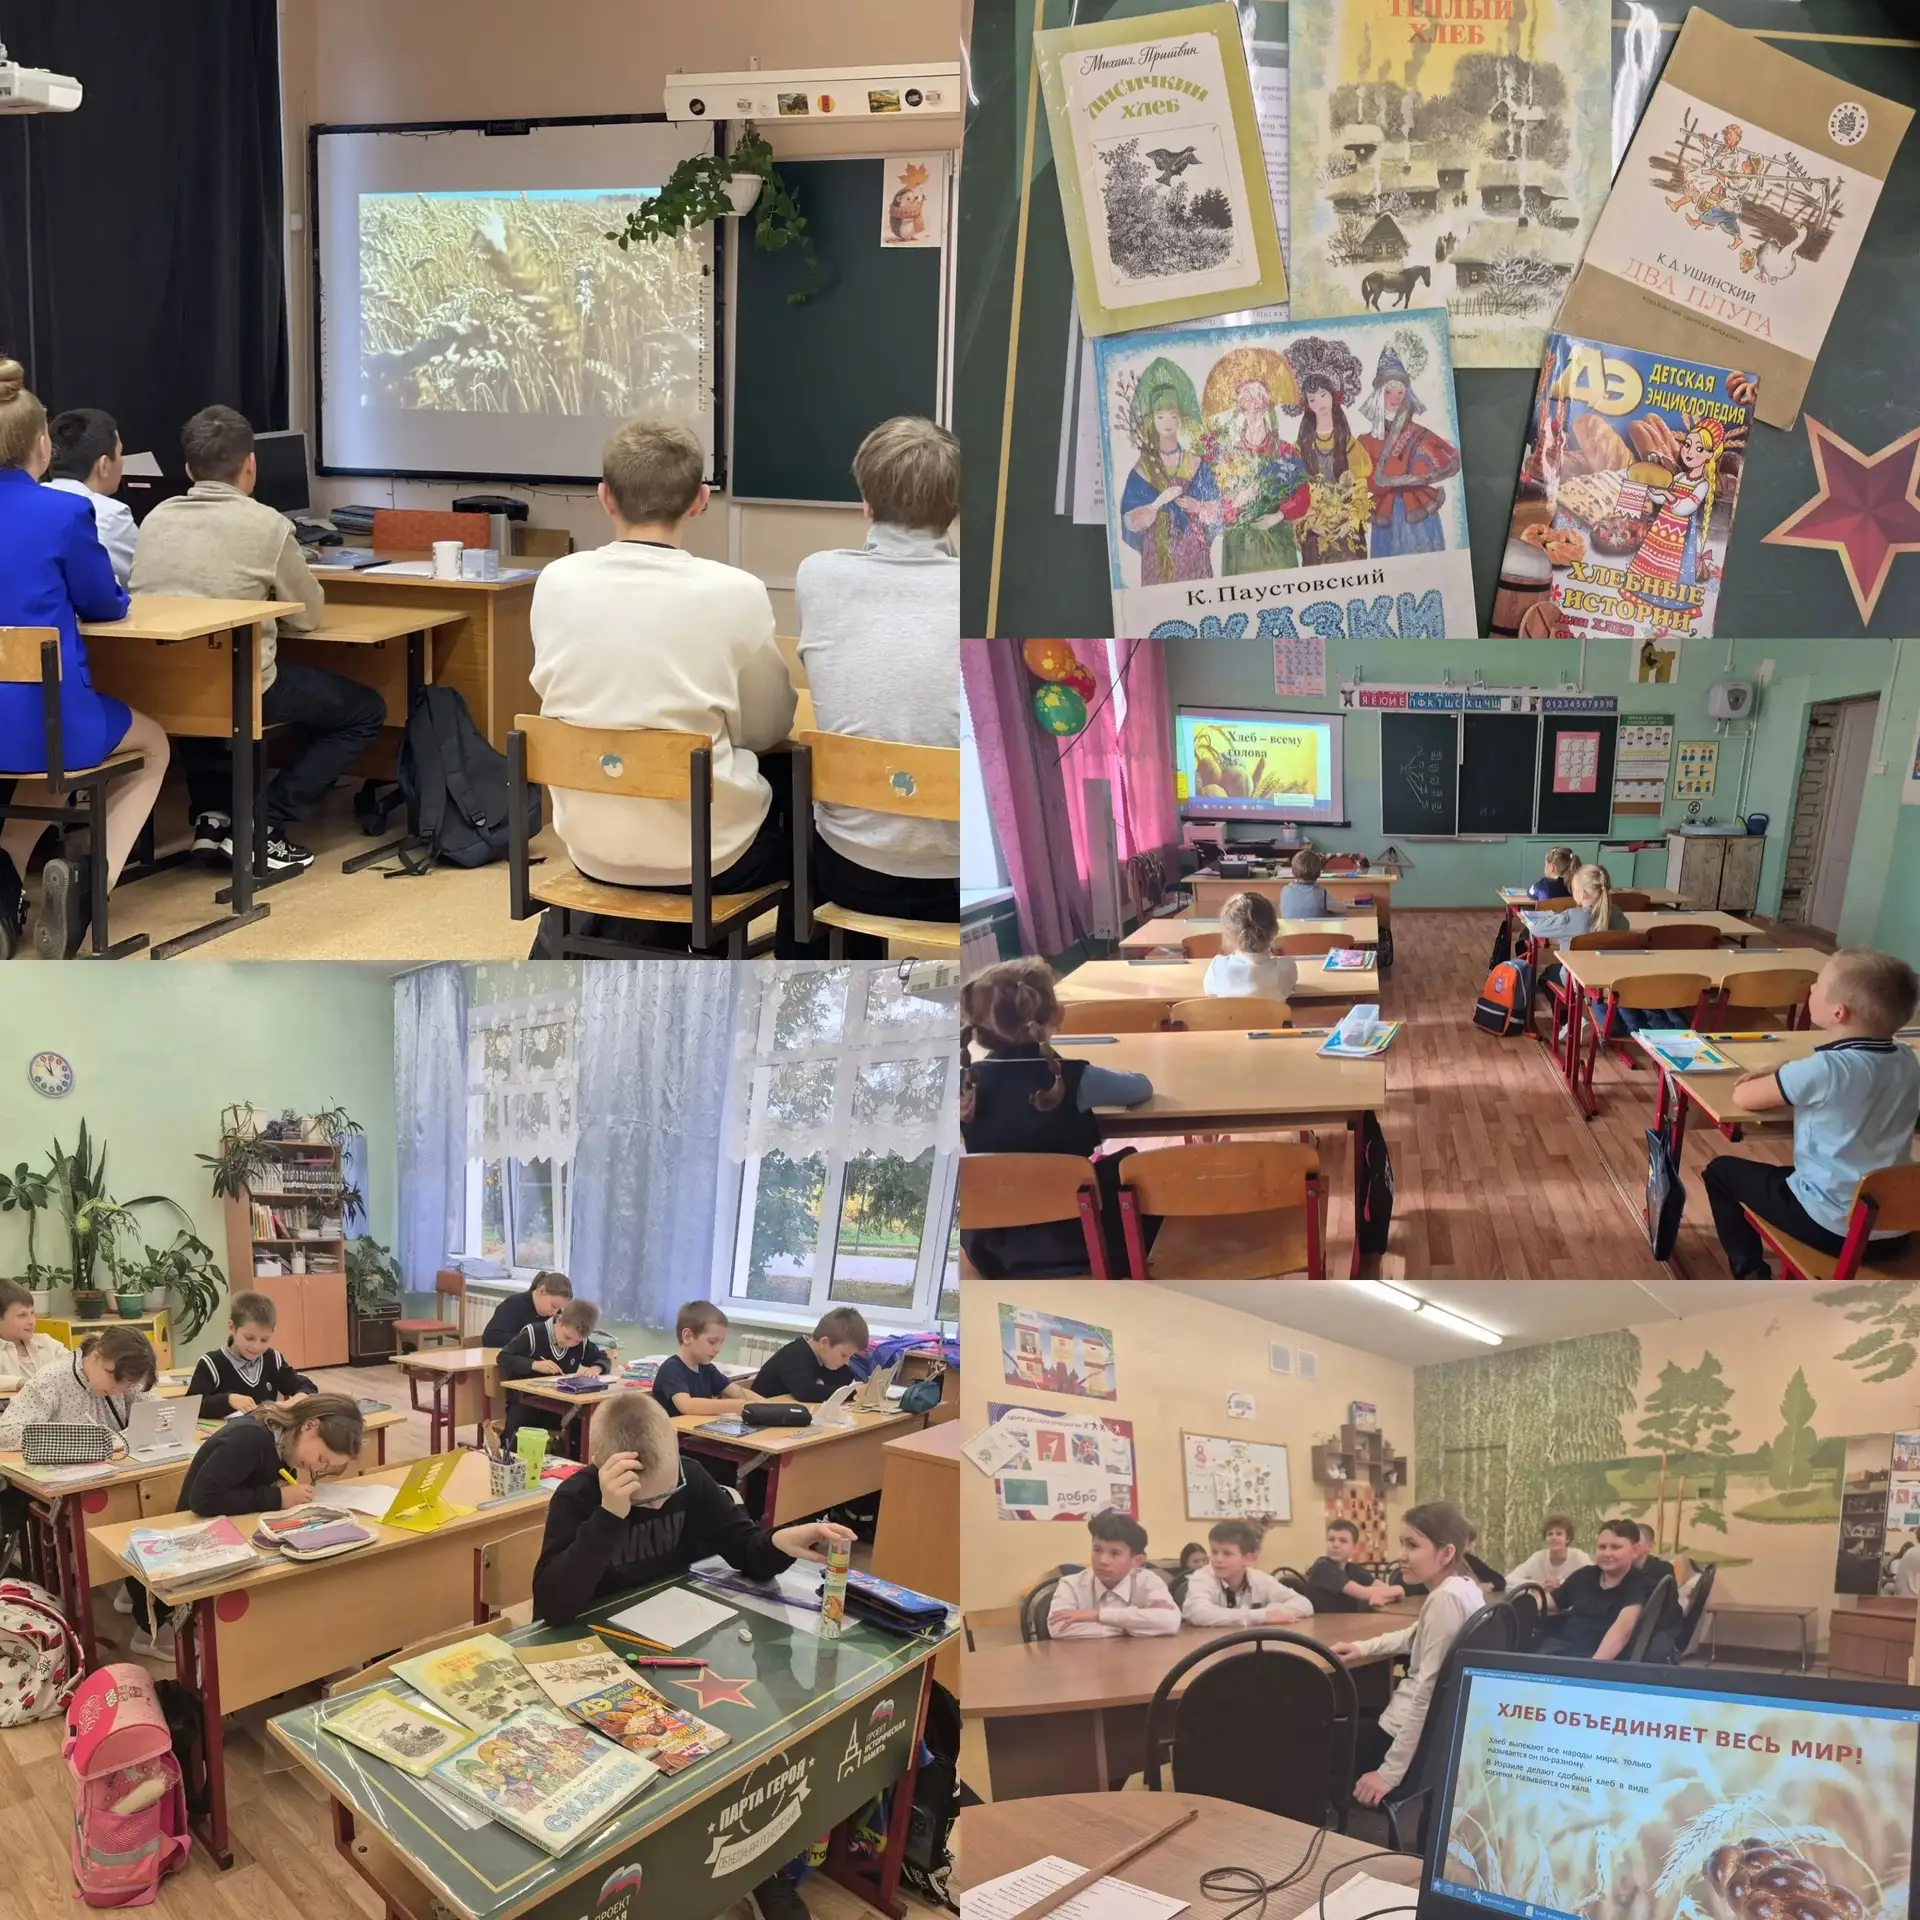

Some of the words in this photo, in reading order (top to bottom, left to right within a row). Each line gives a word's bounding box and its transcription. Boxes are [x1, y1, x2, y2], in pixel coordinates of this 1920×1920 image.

[1407, 23, 1485, 45] ХЛЕБ
[1080, 54, 1136, 76] Михаил
[1138, 41, 1200, 72] Пришвин
[1656, 252, 1667, 267] К.
[1682, 263, 1757, 305] УШИНСКИЙ
[1620, 257, 1676, 297] ДВА
[1685, 283, 1773, 338] ПЛУГА
[1551, 344, 1644, 417] ДЭ
[1649, 363, 1716, 393] ДЕТСКАЯ
[1644, 387, 1746, 425] ЭНЦИКЛОПЕДИЯ
[1185, 589, 1212, 607] К.
[1217, 568, 1386, 604] Паустовский
[1567, 560, 1705, 607] ХЛЕБНЫЕ
[1561, 588, 1698, 638] ИСТОРИИ,
[1227, 731, 1257, 743] Хлеб
[1270, 735, 1303, 748] всему
[1227, 748, 1268, 759] голова
[1497, 1702, 1547, 1722] ХЛЕБ
[1553, 1709, 1708, 1744] ОБЪЕДИНЯЕТ
[1716, 1730, 1780, 1754] ВЕСЬ
[1791, 1739, 1863, 1765] МИР!
[1487, 1747, 1527, 1759] называется
[1528, 1753, 1538, 1761] он
[1539, 1755, 1585, 1769] по-разному.
[1488, 1737, 1506, 1746] Хлеб
[1508, 1740, 1544, 1752] выпекают
[1547, 1746, 1560, 1754] все
[1562, 1749, 1593, 1760] народы
[1595, 1754, 1619, 1764] мира,
[1623, 1758, 1652, 1769] только
[1484, 1769, 1514, 1779] косички.
[1515, 1773, 1559, 1788] Называется
[1559, 1782, 1570, 1790] он
[1571, 1783, 1592, 1794] хала.
[1486, 1758, 1492, 1766] В
[1494, 1760, 1524, 1772] Израиле
[1526, 1766, 1555, 1776] делают
[1557, 1770, 1593, 1783] сдобный
[1595, 1777, 1616, 1788] хлеб
[1627, 1784, 1650, 1794] виде
[719, 1787, 764, 1832] ПАРТА
[766, 1757, 806, 1799] ГЕРОЯ
[594, 1892, 632, 1920] ПРОЕКТ
